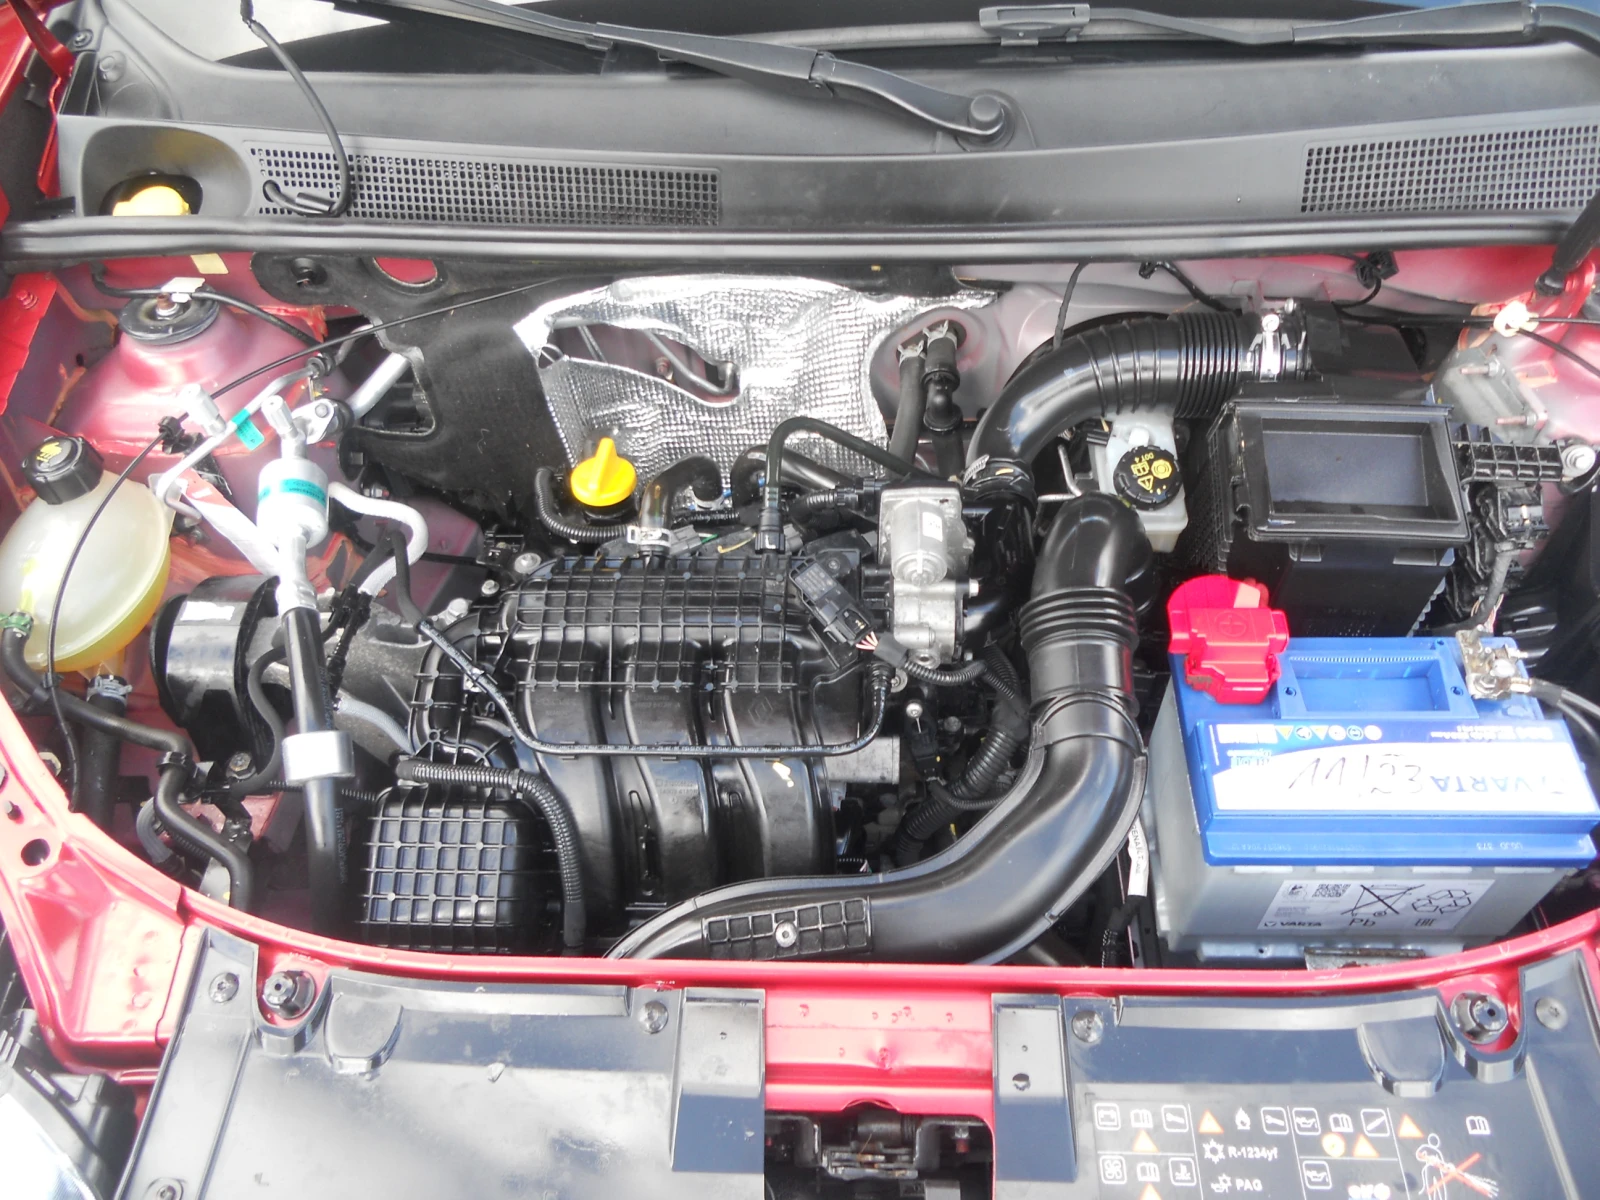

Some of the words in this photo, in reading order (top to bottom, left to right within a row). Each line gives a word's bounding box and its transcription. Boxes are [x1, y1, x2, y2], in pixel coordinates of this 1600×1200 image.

[1429, 775, 1534, 793] VARTA
[1348, 917, 1376, 928] Pb
[1227, 1145, 1279, 1162] R-1234yf
[1235, 1178, 1263, 1192] PAG
